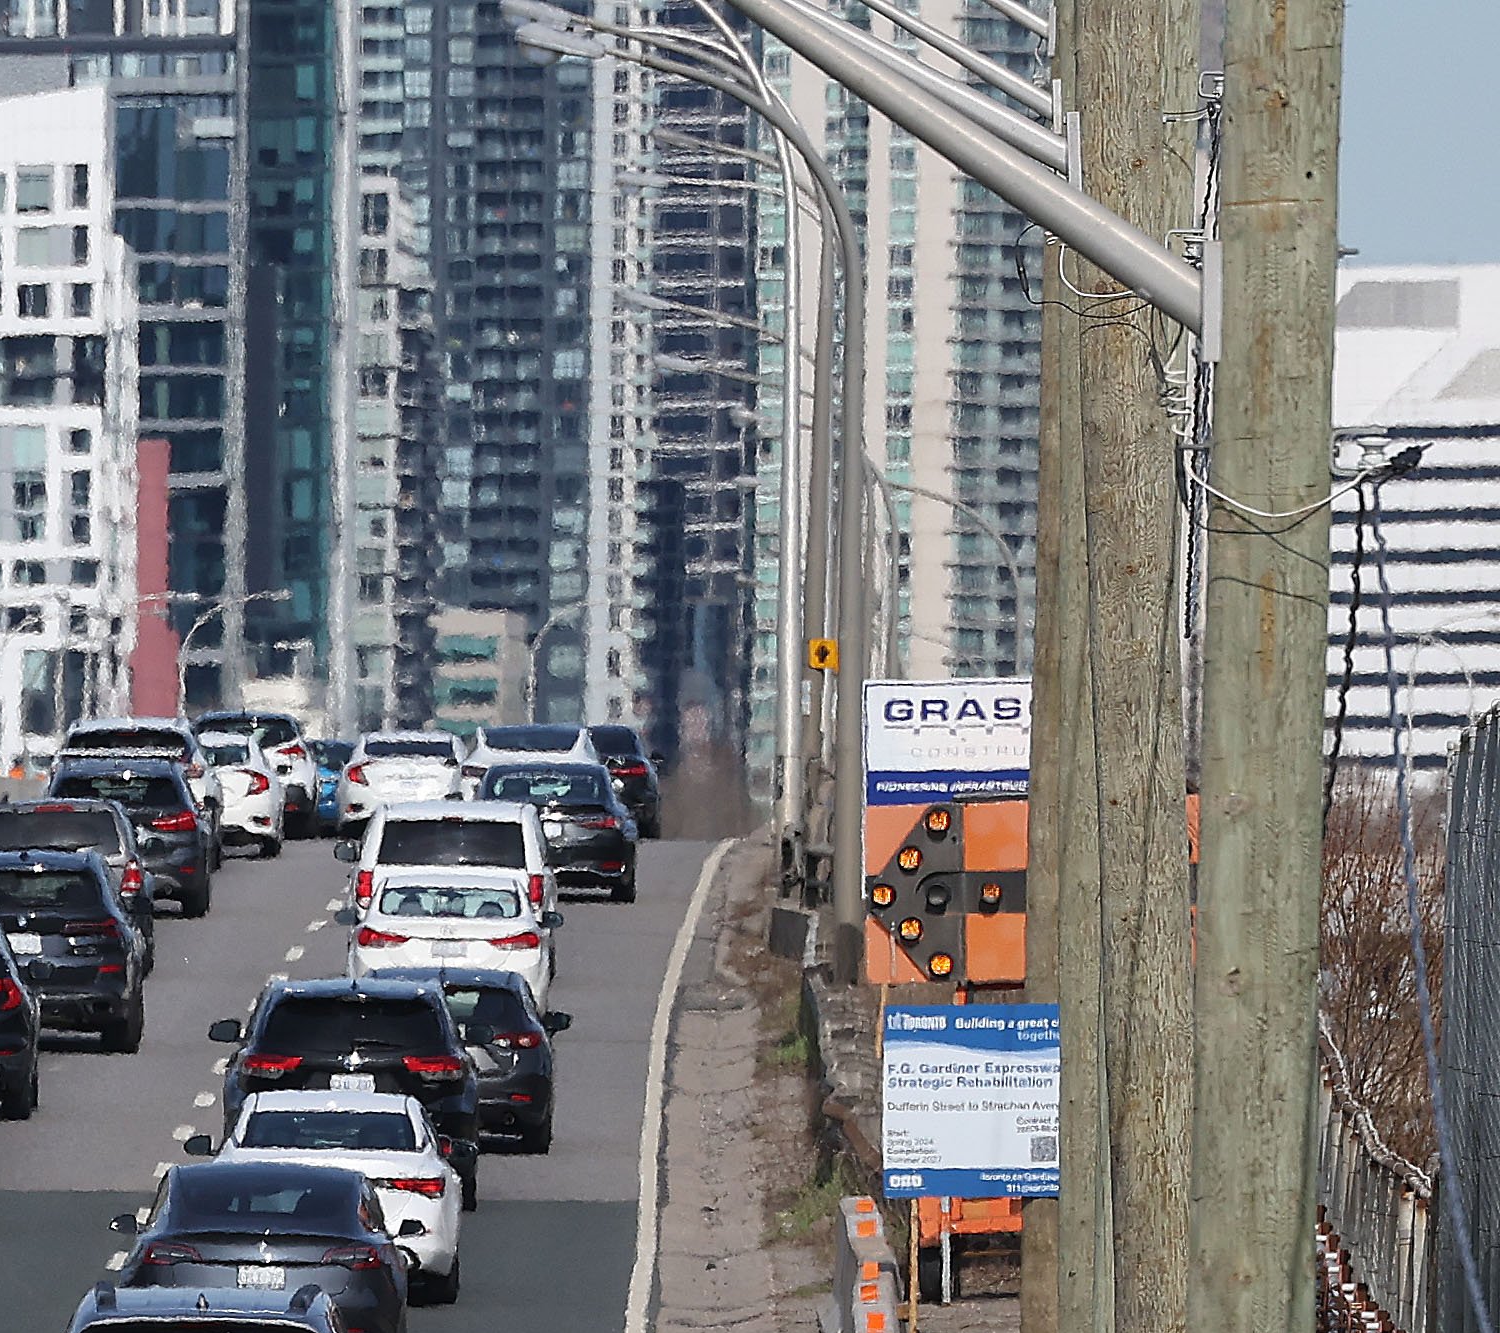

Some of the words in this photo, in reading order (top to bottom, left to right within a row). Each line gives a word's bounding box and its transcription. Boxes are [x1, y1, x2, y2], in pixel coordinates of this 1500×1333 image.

[955, 1017, 1005, 1031] Building
[1007, 1021, 1015, 1030] a
[1017, 1018, 1049, 1031] great
[887, 1063, 915, 1075] F.G.
[919, 1063, 980, 1075] Gardiner
[887, 1077, 952, 1091] Strategic
[956, 1076, 1053, 1089] Rehabilitation
[887, 1101, 930, 1112] Dufferin
[932, 1101, 966, 1112] Street
